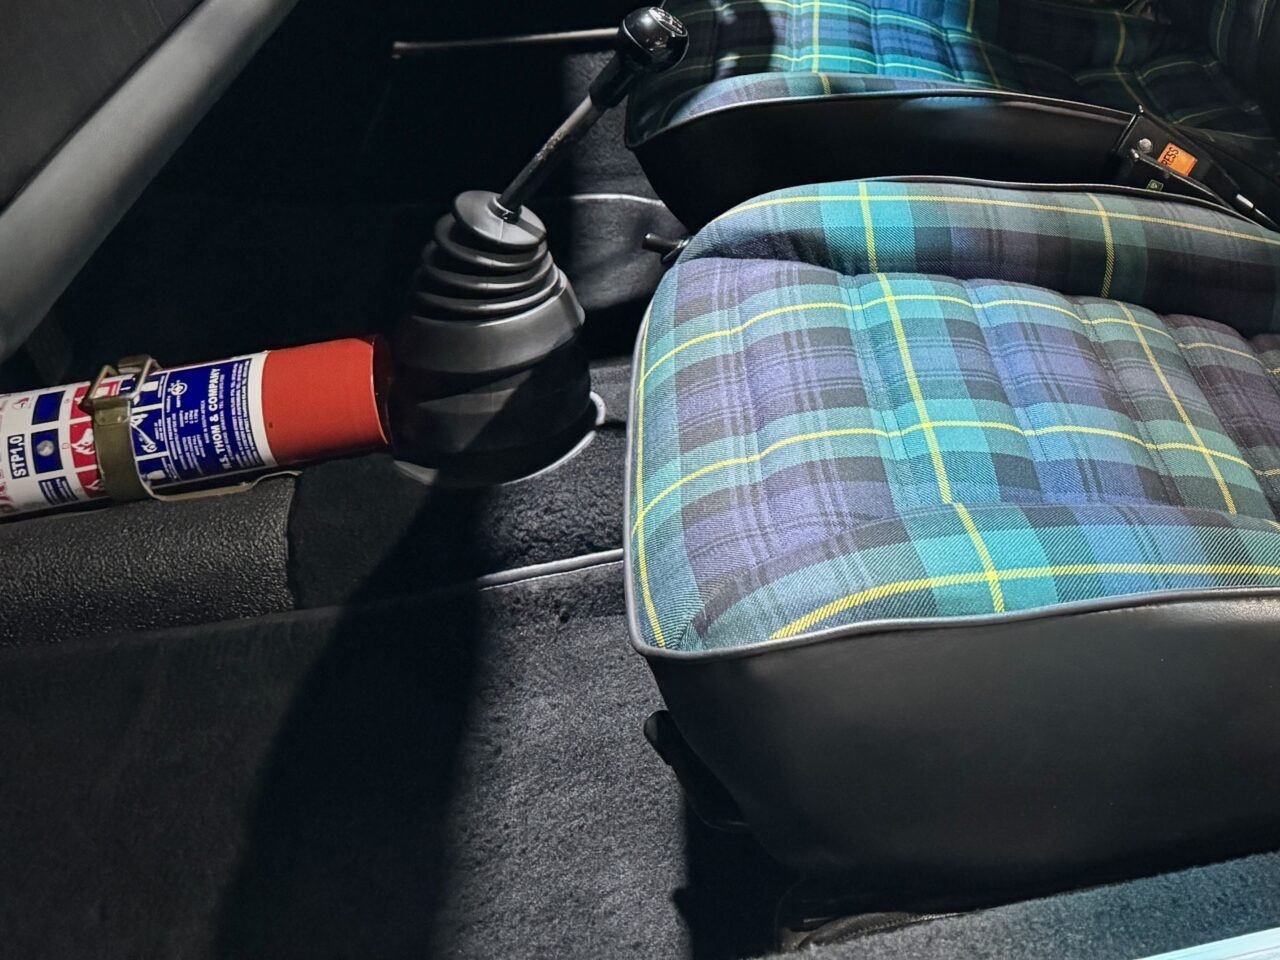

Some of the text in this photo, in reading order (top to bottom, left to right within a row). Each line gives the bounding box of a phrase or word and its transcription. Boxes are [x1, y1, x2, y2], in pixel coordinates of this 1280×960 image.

[1161, 147, 1178, 165] RESS
[208, 368, 220, 412] COMPANY
[209, 413, 219, 422] &
[210, 424, 225, 454] THOM
